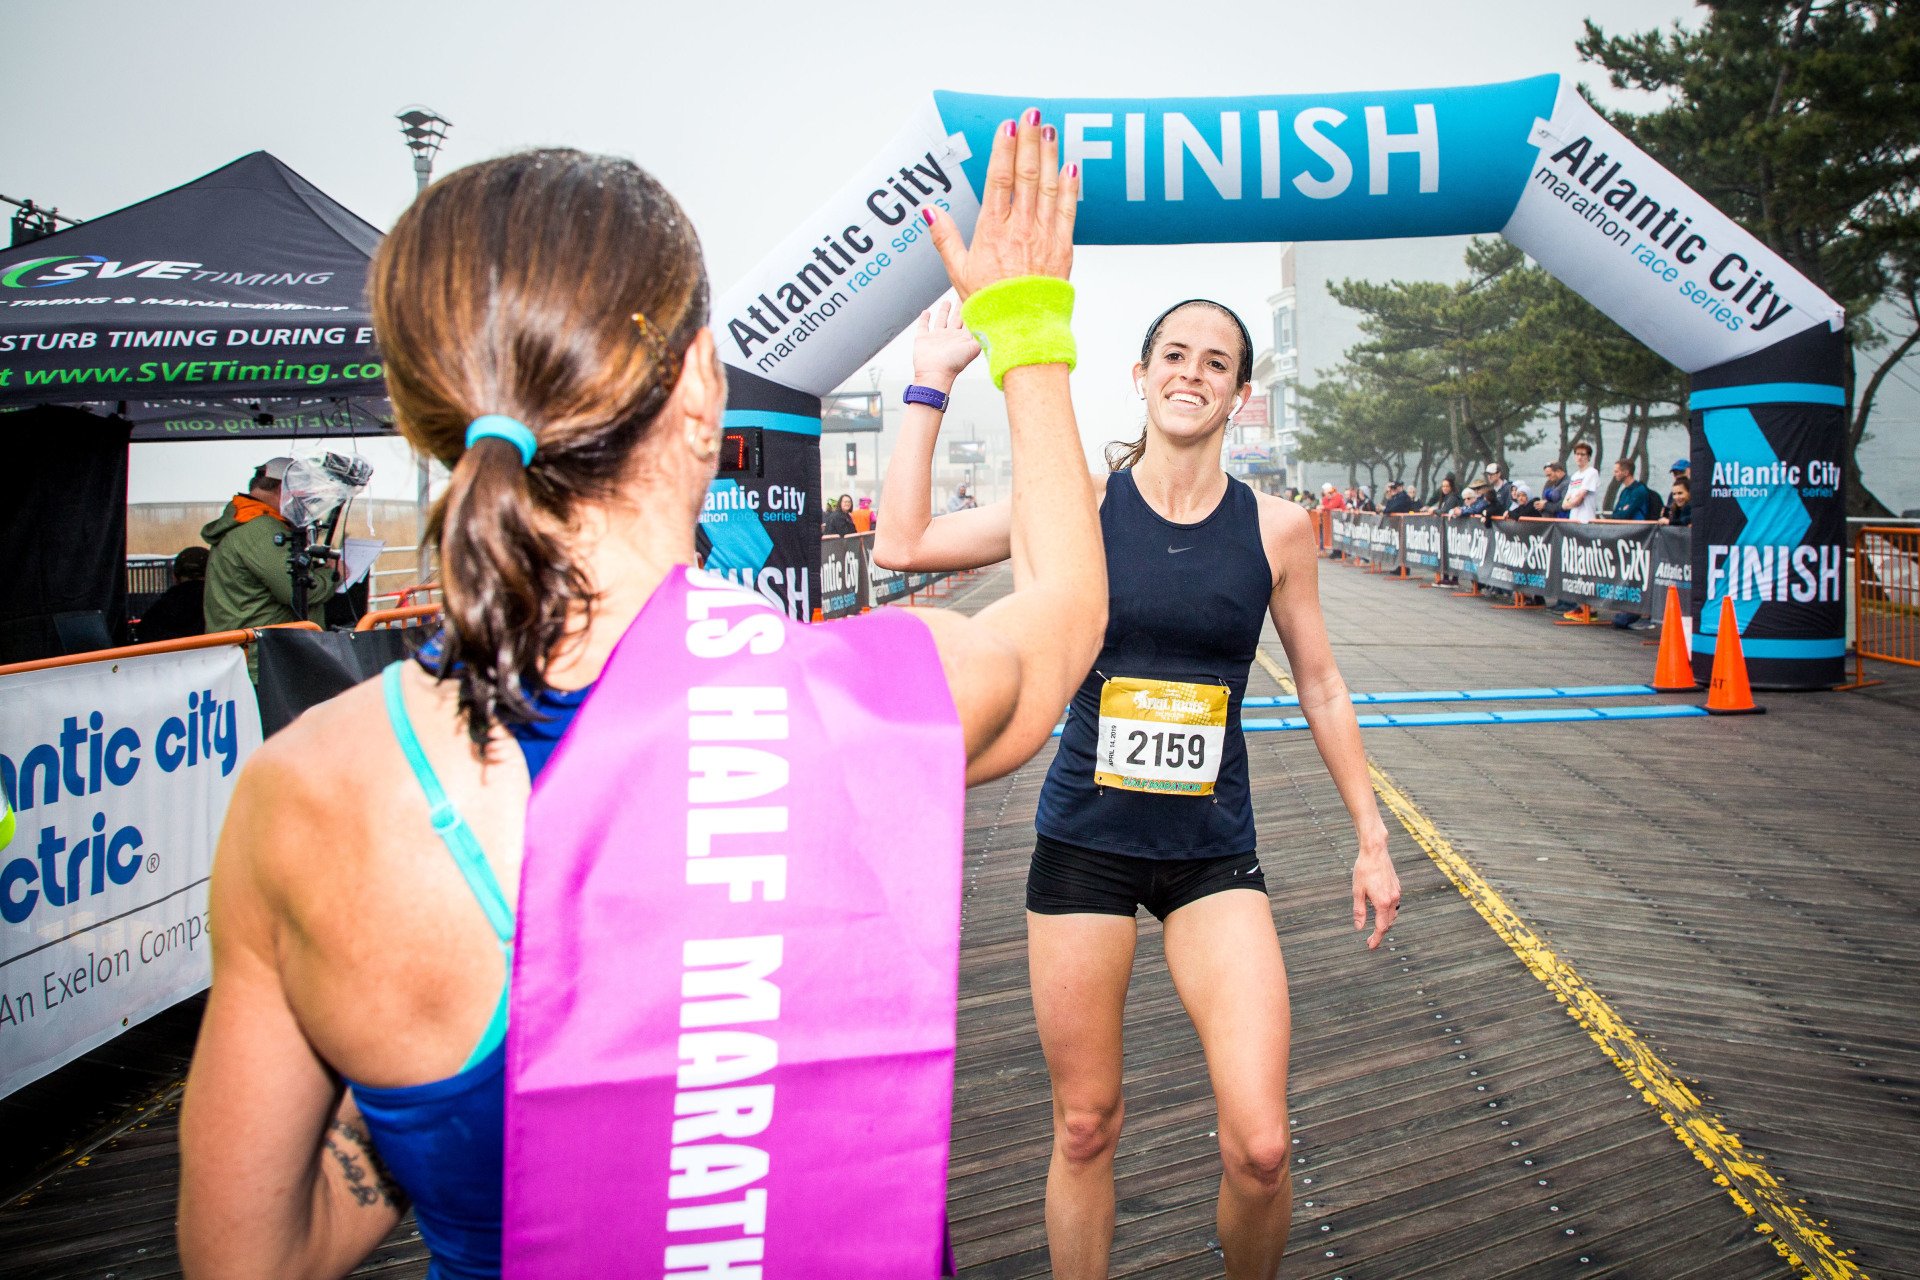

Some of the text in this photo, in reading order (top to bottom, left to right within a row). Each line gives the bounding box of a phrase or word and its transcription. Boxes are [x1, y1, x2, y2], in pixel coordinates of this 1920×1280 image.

[1063, 103, 1440, 202] FINISH
[727, 152, 952, 359] Atlantic City
[1535, 166, 1744, 332] marathon race series
[1550, 136, 1793, 332] Atlantic City
[37, 260, 335, 286] SVE TIMING
[756, 196, 951, 373] marathon race seris
[9, 297, 112, 307] TIMING
[108, 329, 218, 348] TIMING
[226, 327, 347, 346] DURING
[355, 326, 376, 345] E
[25, 359, 388, 386] www.SVETiming.co
[726, 433, 745, 470] 7
[1711, 459, 1841, 491] Atlantic City
[697, 510, 729, 523] athon
[762, 509, 798, 522] series
[767, 484, 806, 516] City
[1711, 486, 1769, 498] marathon
[1561, 536, 1651, 592] Atlantic City
[1562, 577, 1595, 596] marathon
[1706, 544, 1841, 602] FINISH
[155, 689, 238, 778] city
[1125, 729, 1206, 770] 2159
[686, 686, 790, 903] HALF
[0, 811, 144, 924] ctric
[0, 990, 35, 1027] An
[43, 948, 130, 1010] Exelon
[663, 934, 784, 1280] MARATH
